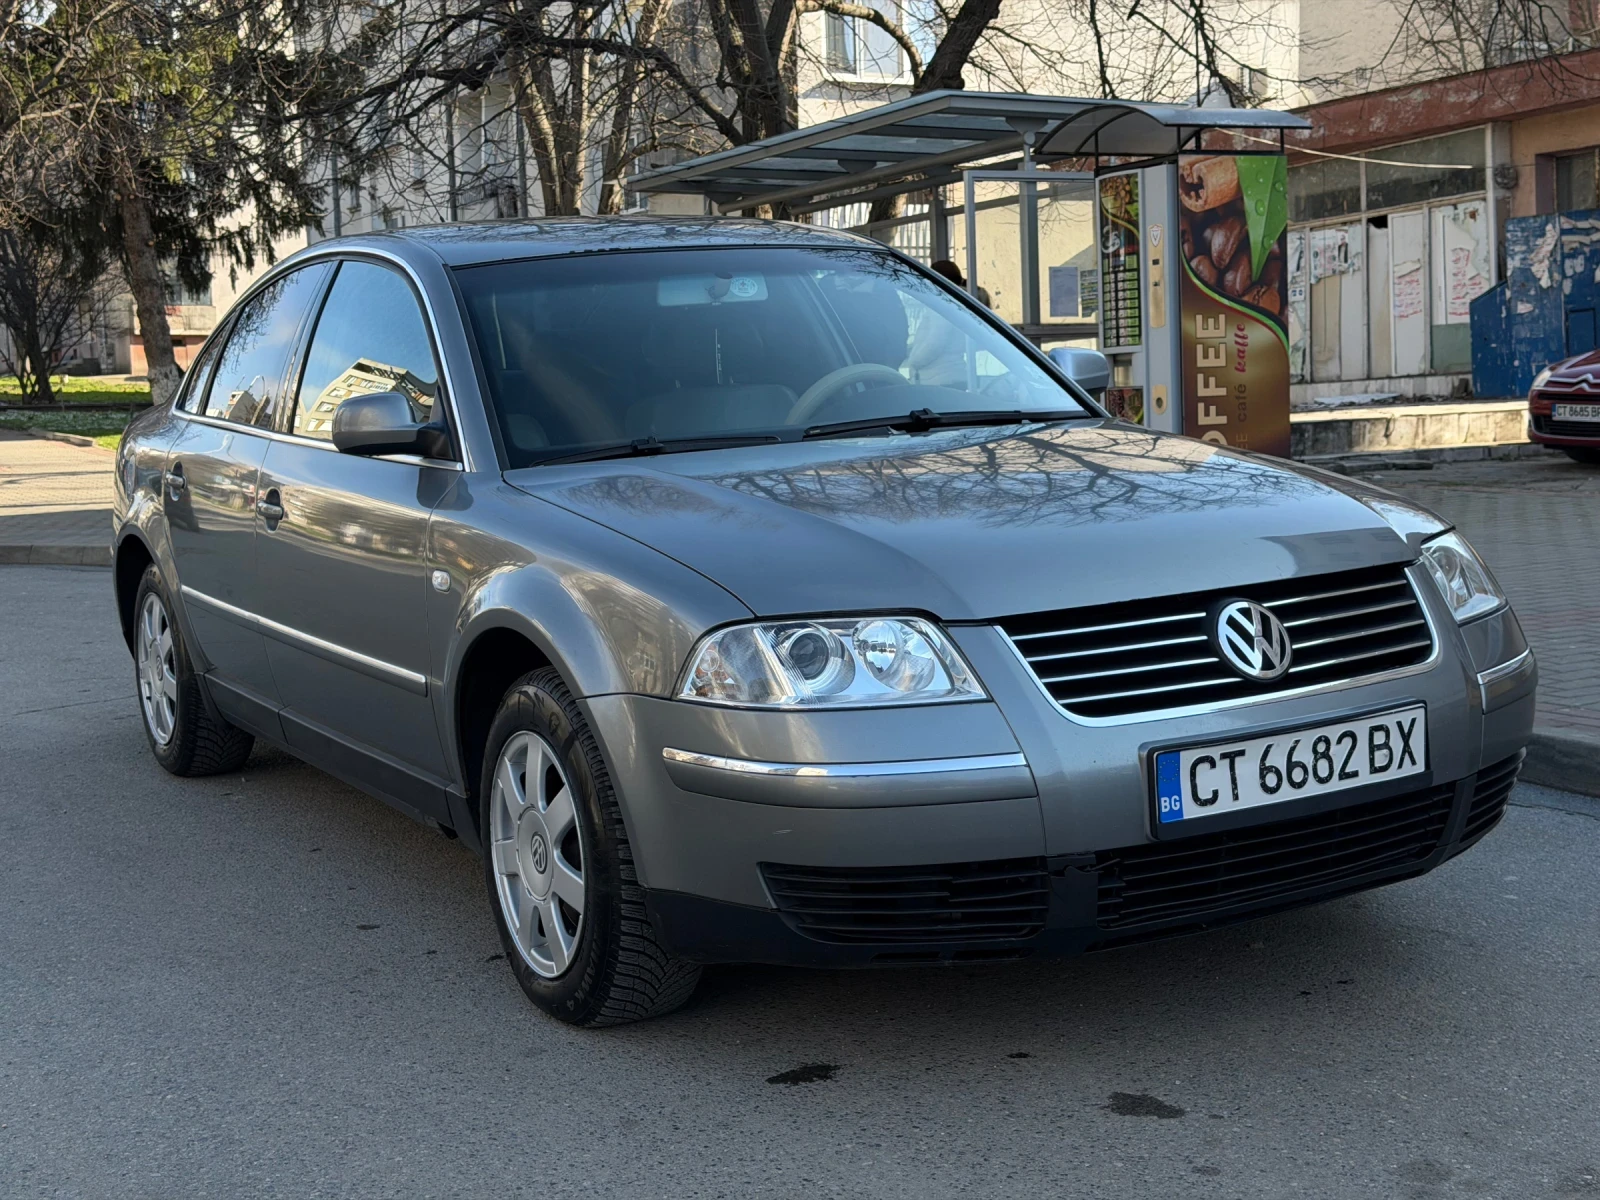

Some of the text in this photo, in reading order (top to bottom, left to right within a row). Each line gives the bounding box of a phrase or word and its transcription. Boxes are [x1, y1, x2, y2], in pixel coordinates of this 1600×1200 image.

[1234, 323, 1249, 373] kaffe
[1234, 384, 1247, 422] café
[1189, 717, 1418, 807] CT 6682 BX
[1160, 795, 1181, 813] BG
